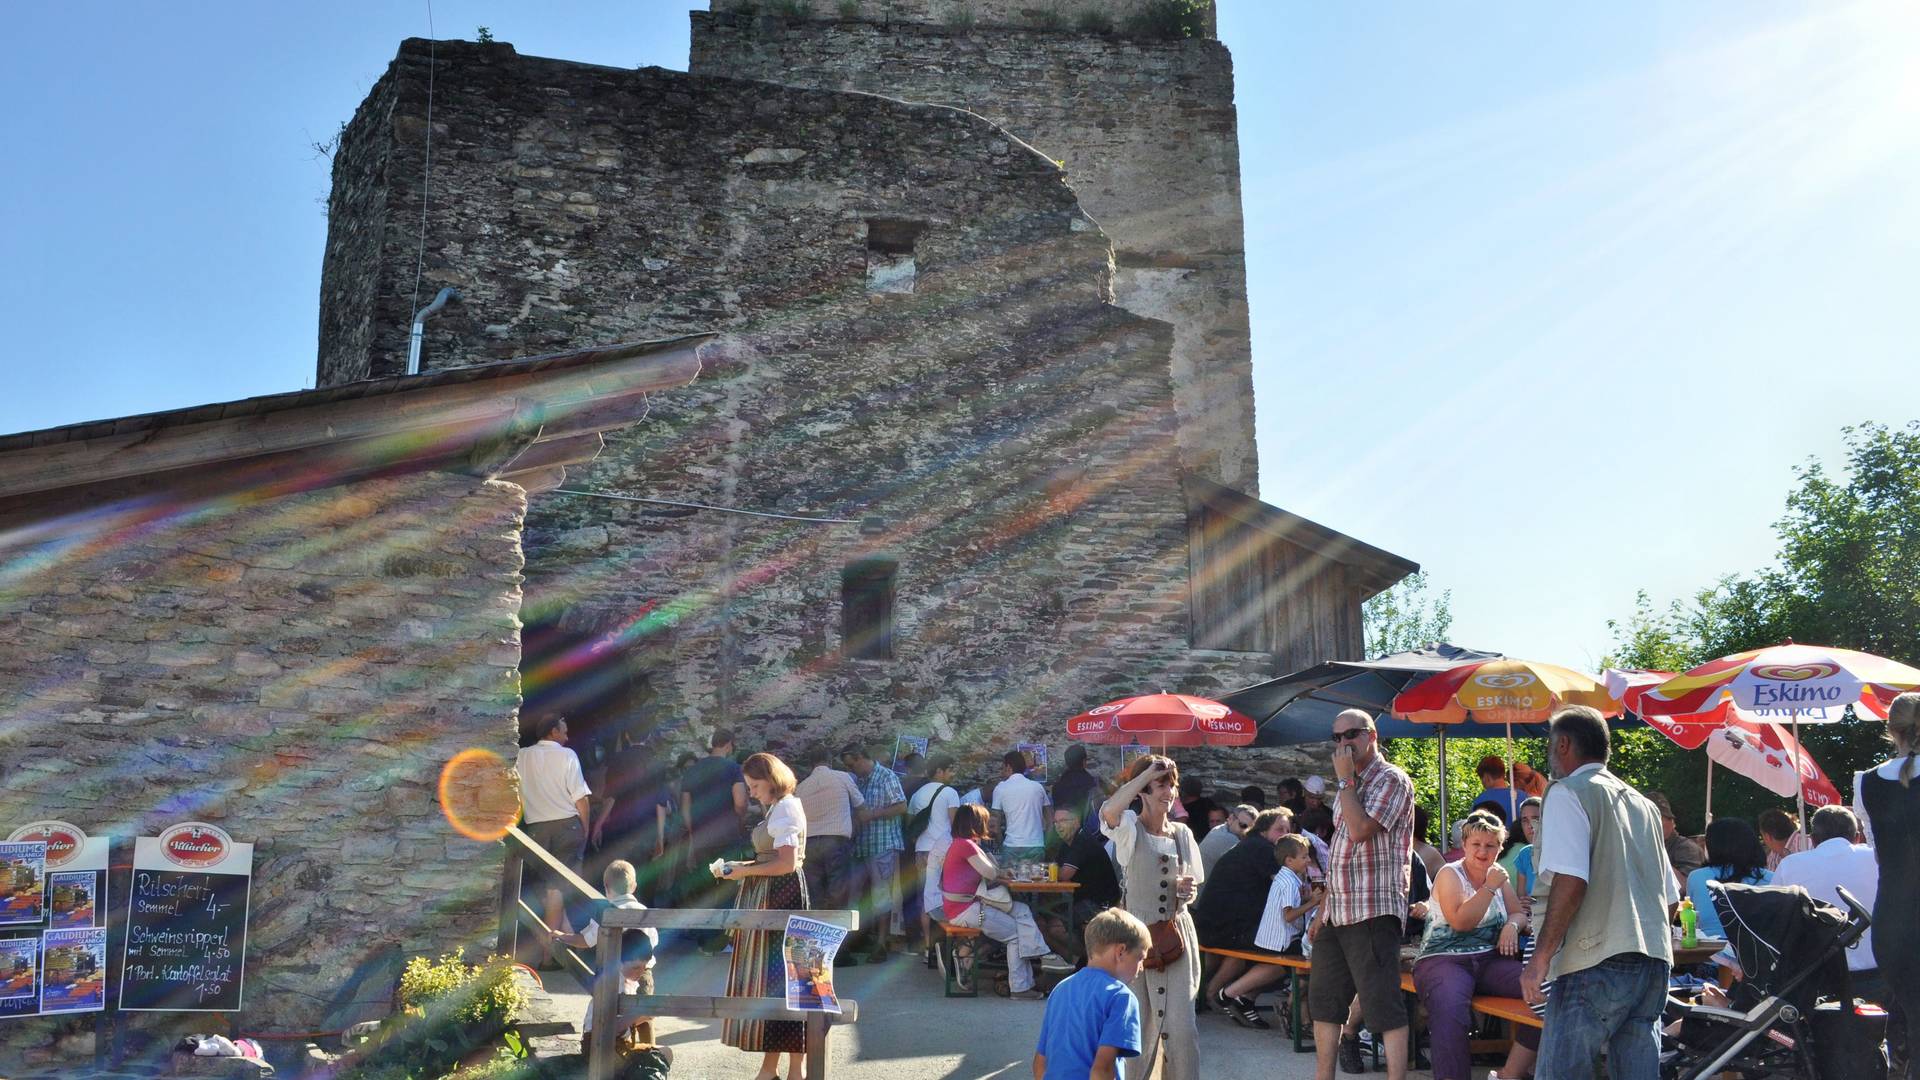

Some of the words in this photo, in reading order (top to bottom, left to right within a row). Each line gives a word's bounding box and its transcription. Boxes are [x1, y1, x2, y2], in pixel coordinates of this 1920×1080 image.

[1753, 683, 1841, 706] Eskimo
[1477, 696, 1533, 707] ESKIMO
[1077, 721, 1104, 731] ESKIMO
[1210, 720, 1241, 731] ESKIMO
[138, 899, 183, 916] Semmel
[150, 945, 189, 957] Semmel
[162, 964, 232, 985] Kartoffelsalat
